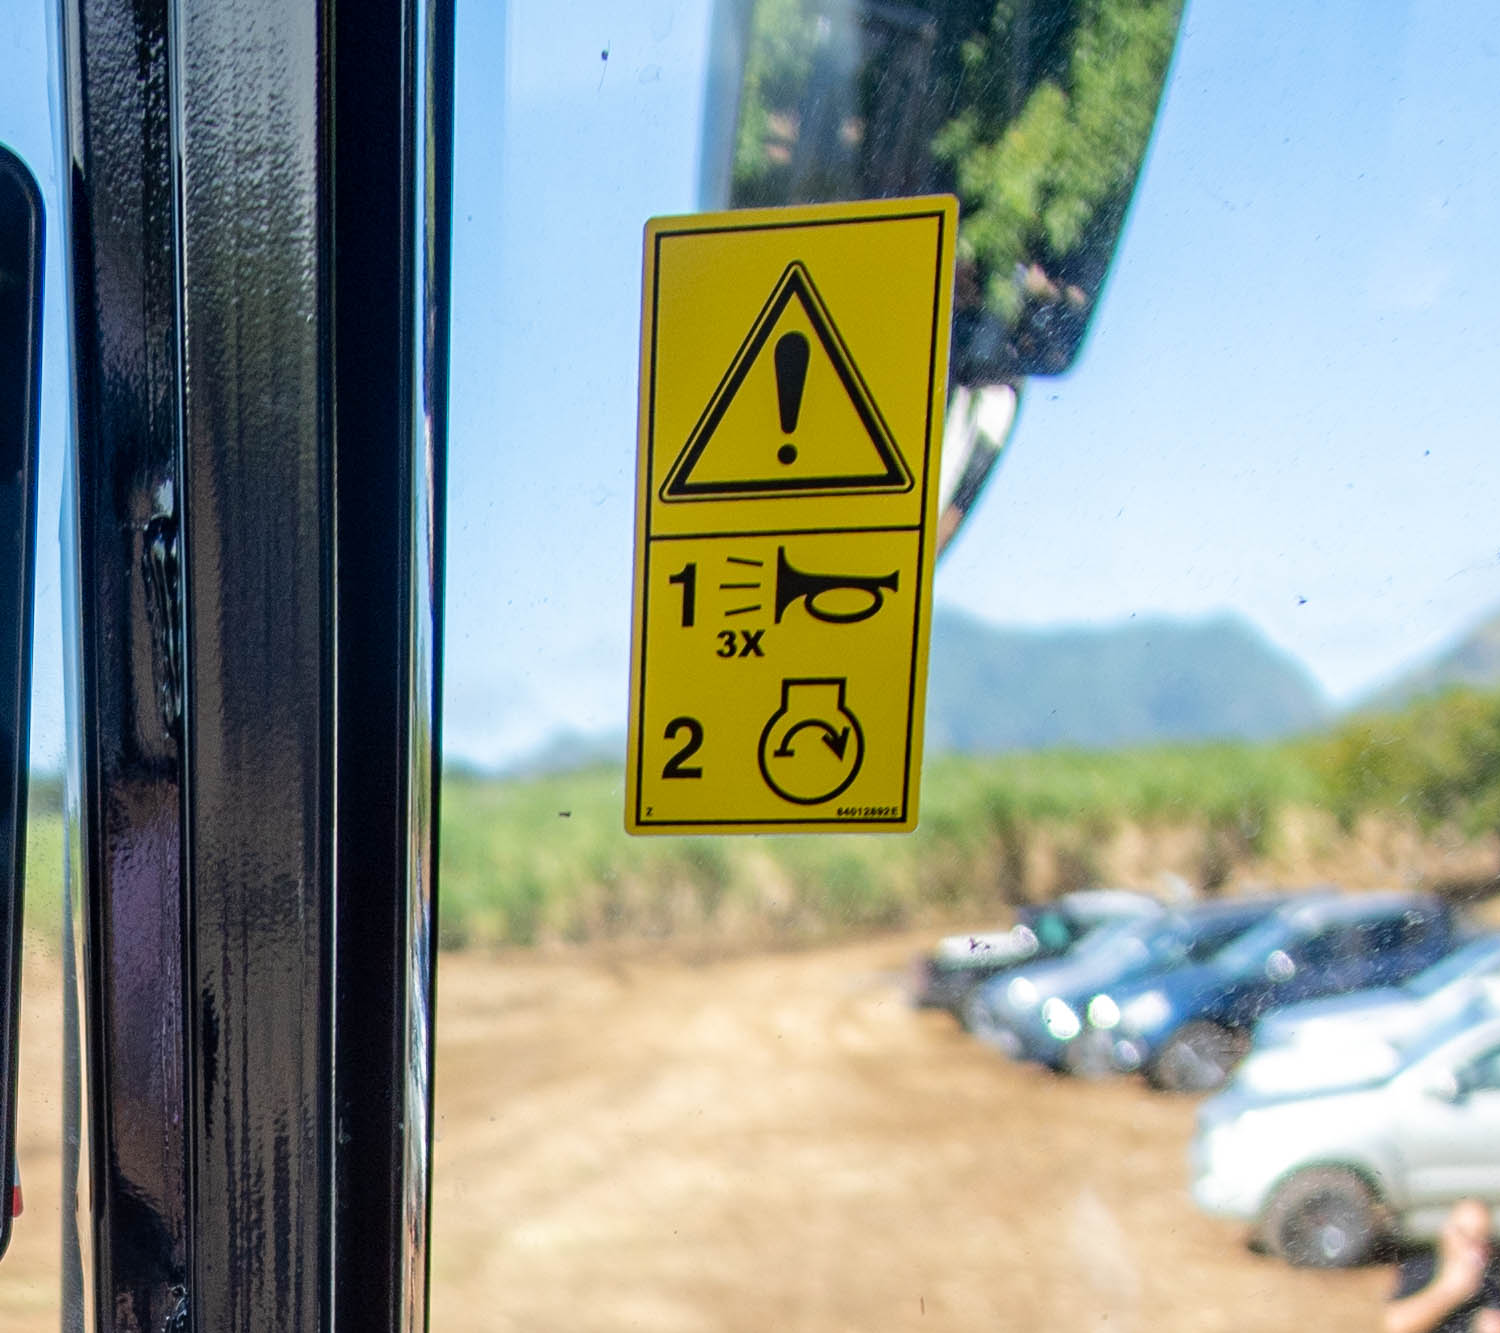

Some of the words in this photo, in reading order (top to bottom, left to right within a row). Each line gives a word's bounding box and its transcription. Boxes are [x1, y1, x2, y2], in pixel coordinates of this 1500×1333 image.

[669, 562, 696, 628] 1
[716, 629, 765, 658] 3X
[662, 716, 705, 780] 2
